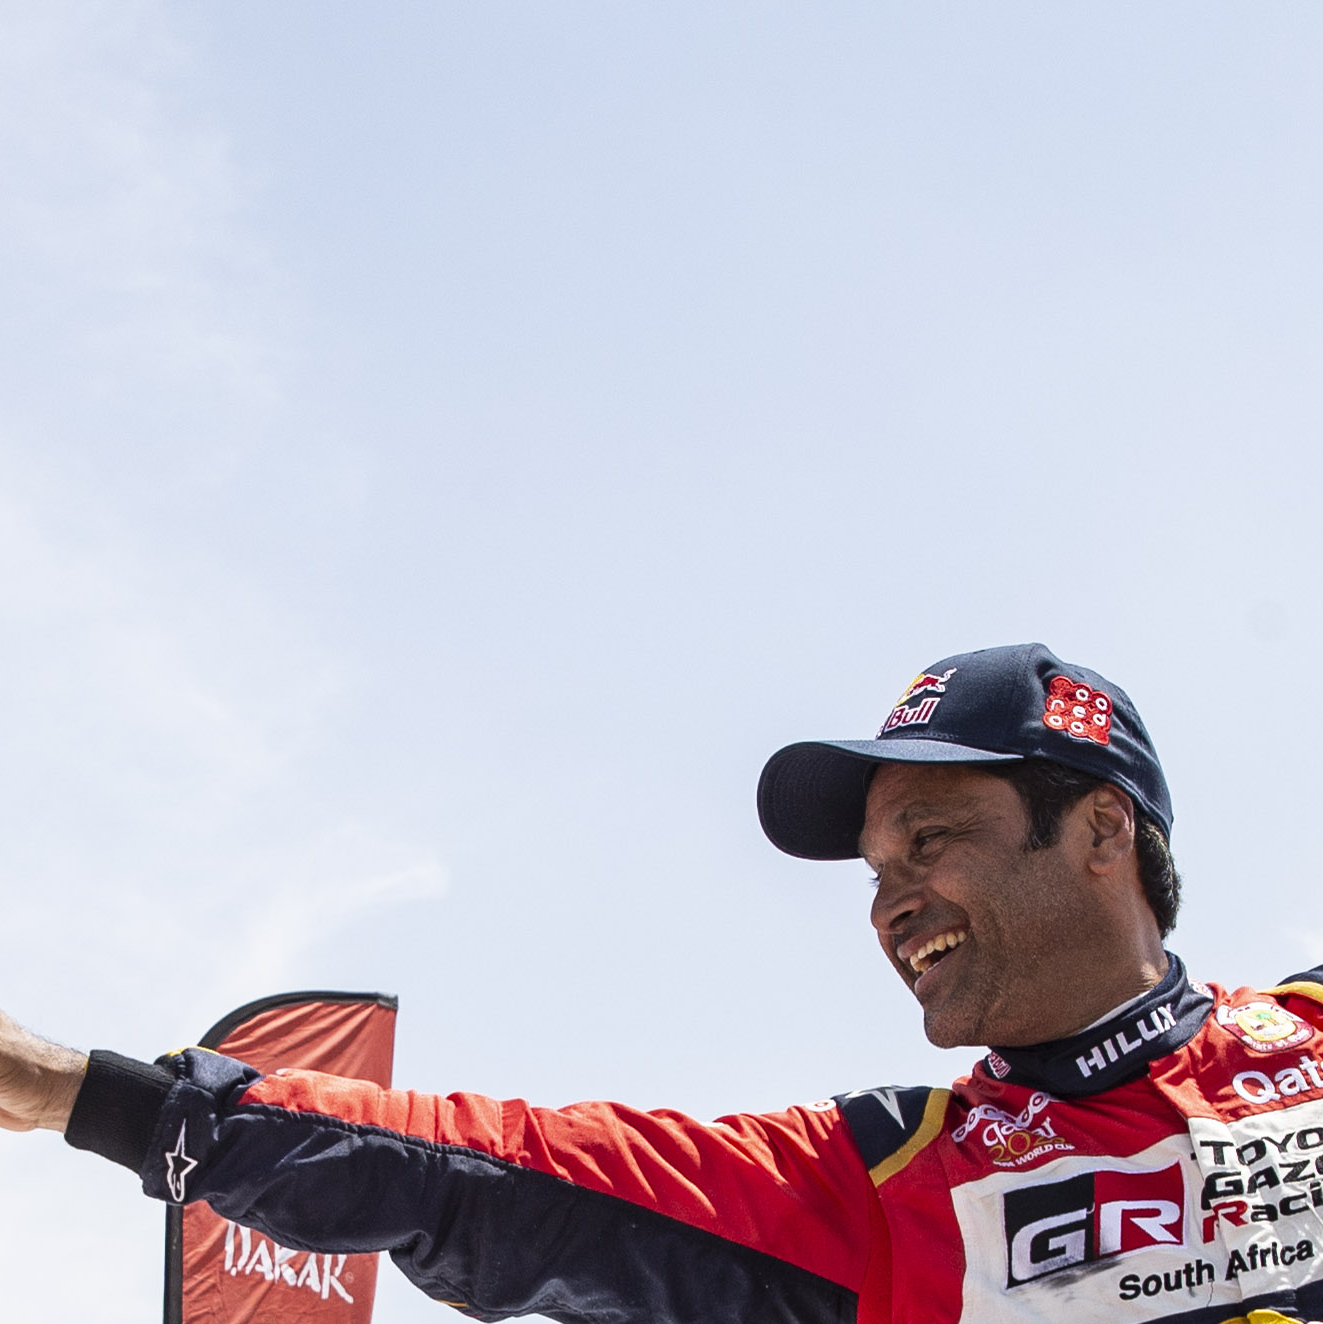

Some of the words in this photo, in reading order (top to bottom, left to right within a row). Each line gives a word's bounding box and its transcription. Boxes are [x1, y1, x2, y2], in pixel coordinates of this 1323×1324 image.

[884, 698, 940, 733] Bull
[1075, 1003, 1177, 1078] HILUX
[224, 1220, 354, 1304] DAKAR
[1011, 1197, 1183, 1284] GR
[1119, 1260, 1214, 1301] South
[1225, 1239, 1315, 1281] Africa
